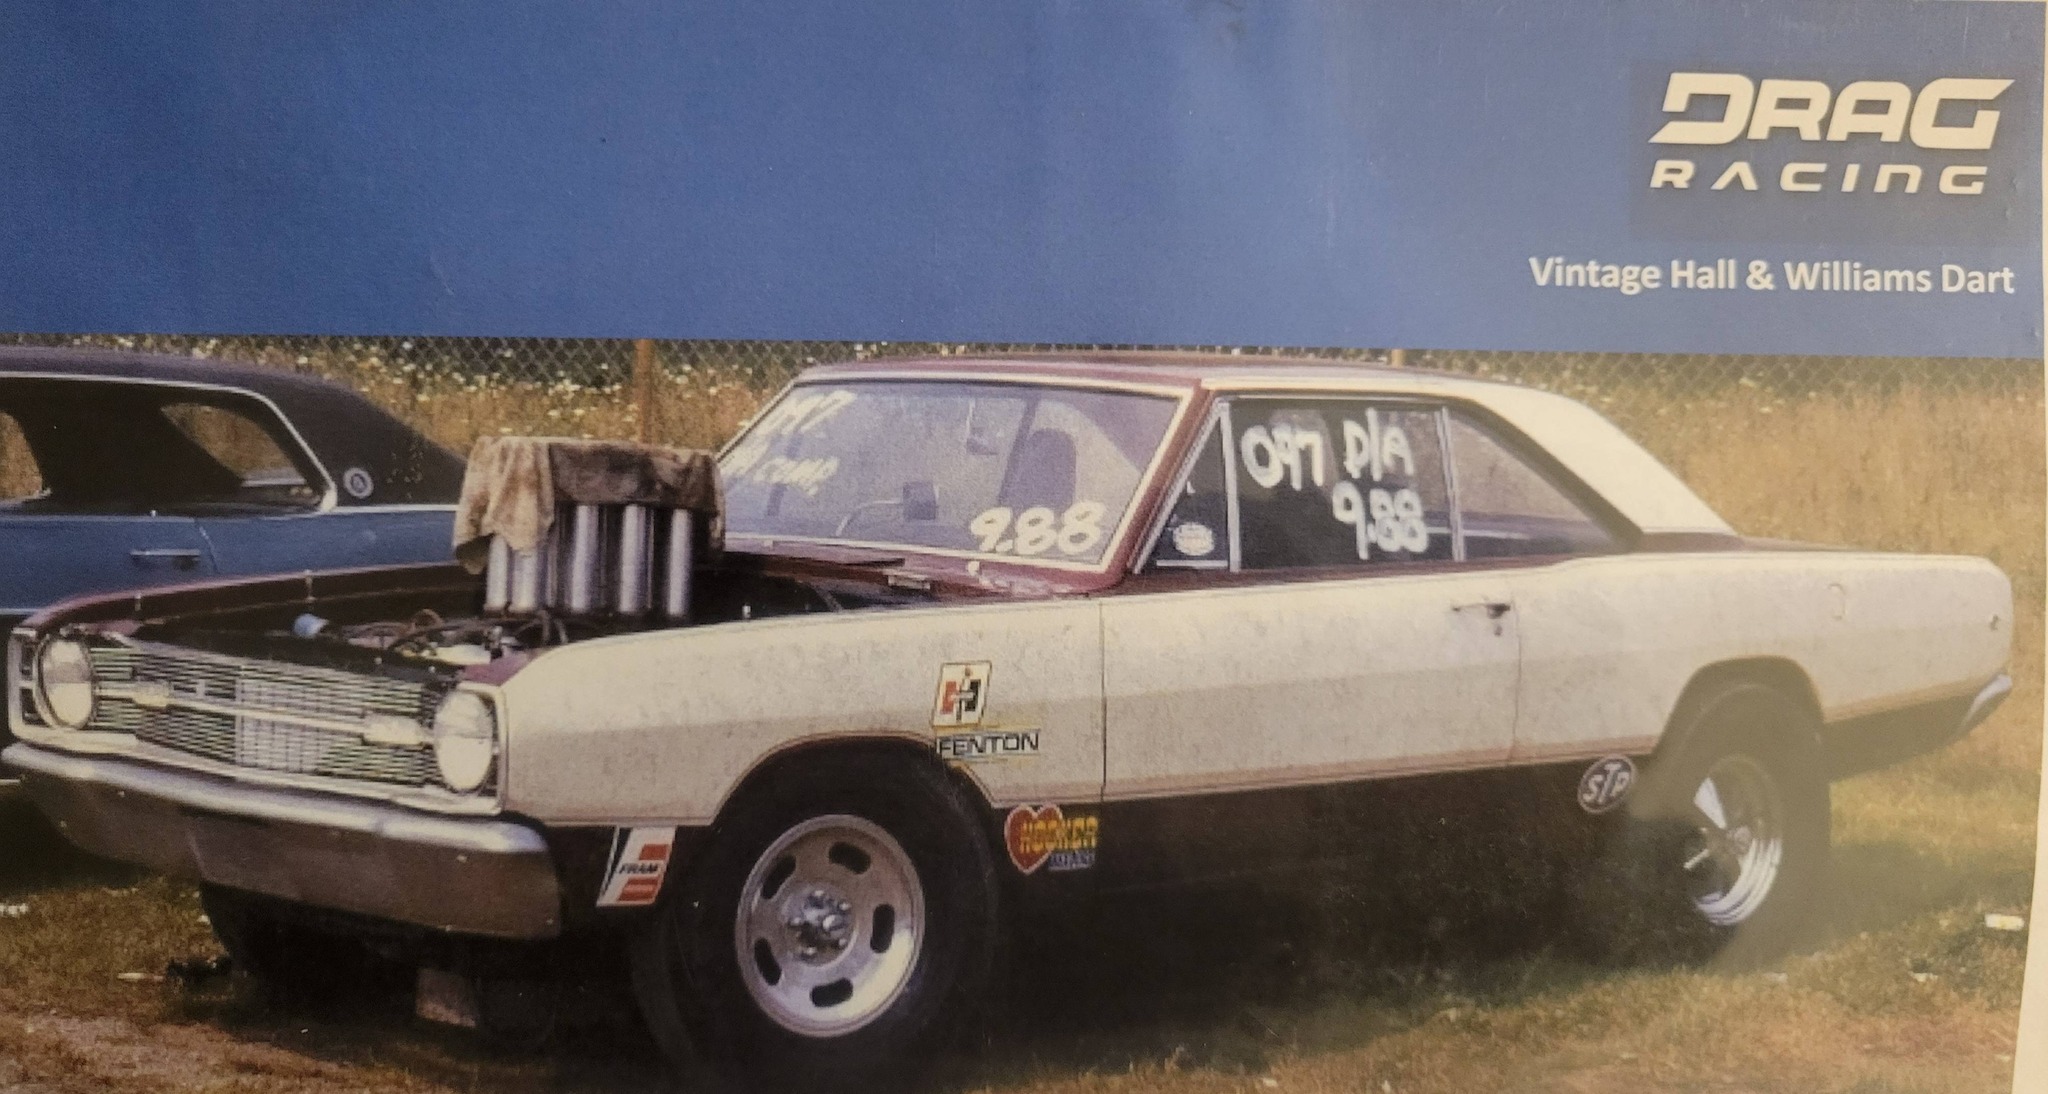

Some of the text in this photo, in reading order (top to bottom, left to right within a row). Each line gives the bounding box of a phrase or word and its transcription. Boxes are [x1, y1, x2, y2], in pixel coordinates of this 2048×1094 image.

[1648, 72, 2015, 149] DRAG
[1649, 159, 1988, 195] RACING
[1528, 256, 2015, 295] Vintage Hall & Williams Dart
[1241, 424, 1324, 491] 097
[970, 501, 1104, 555] 9.88
[1332, 480, 1430, 560] 9.88
[939, 731, 1039, 757] FENTON
[1582, 762, 1631, 804] STP
[619, 862, 659, 876] FRAM
